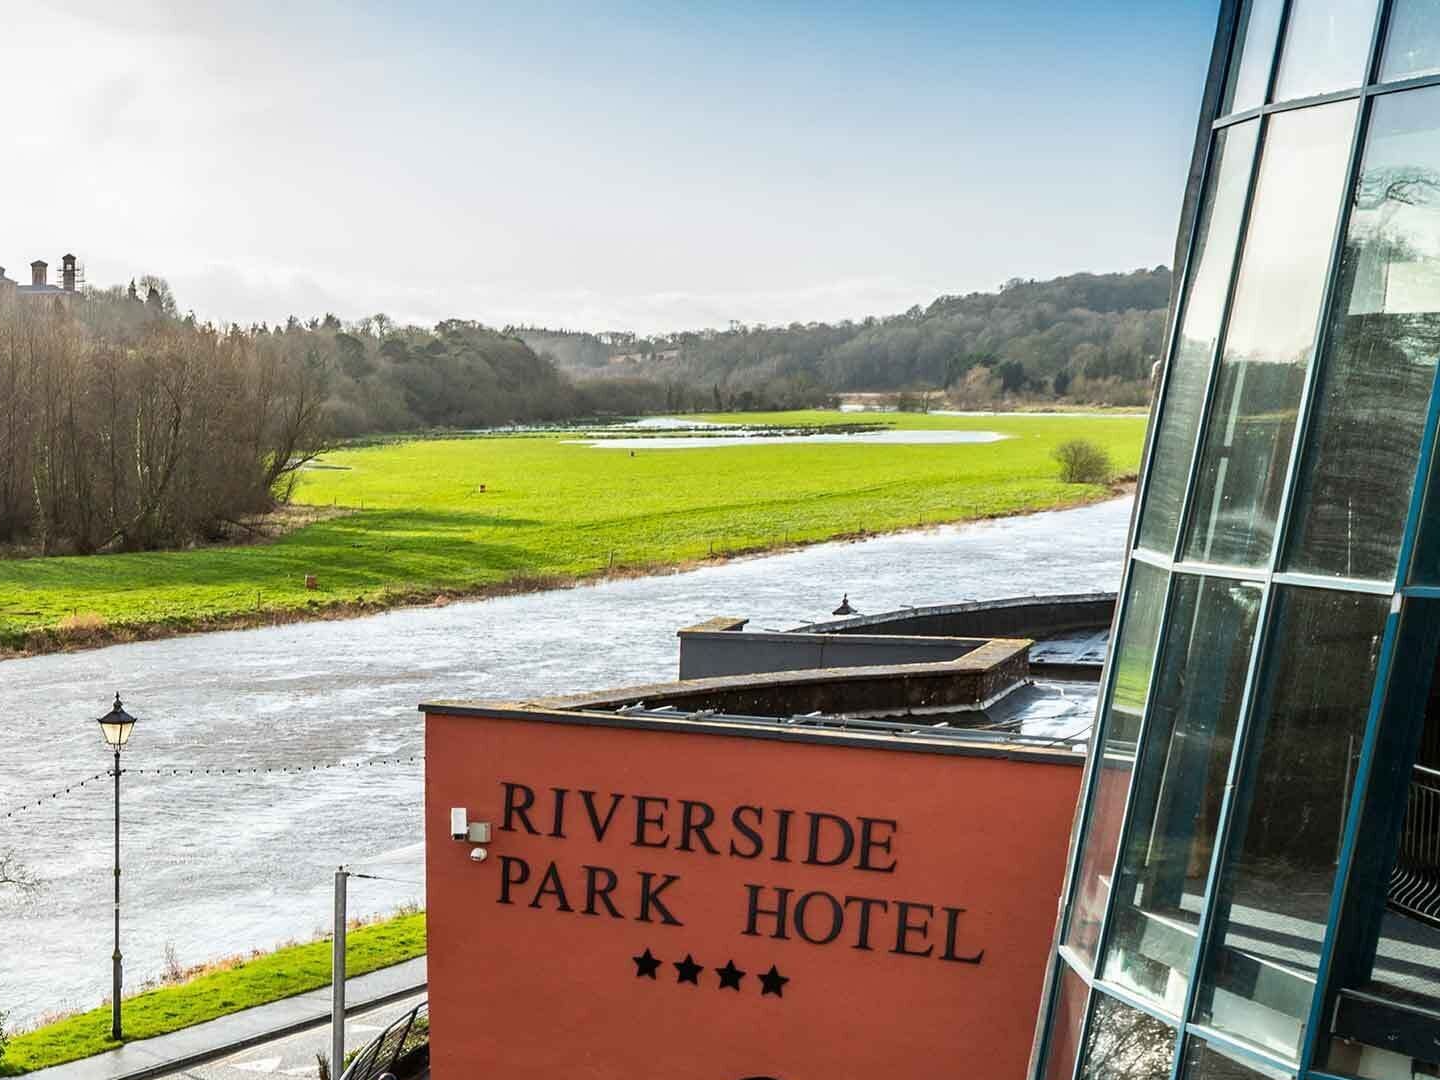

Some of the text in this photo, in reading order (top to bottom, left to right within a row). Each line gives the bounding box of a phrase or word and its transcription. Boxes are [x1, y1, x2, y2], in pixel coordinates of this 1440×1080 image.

[497, 782, 897, 874] RIVERSIDE
[496, 855, 985, 966] PARK HOTEL
